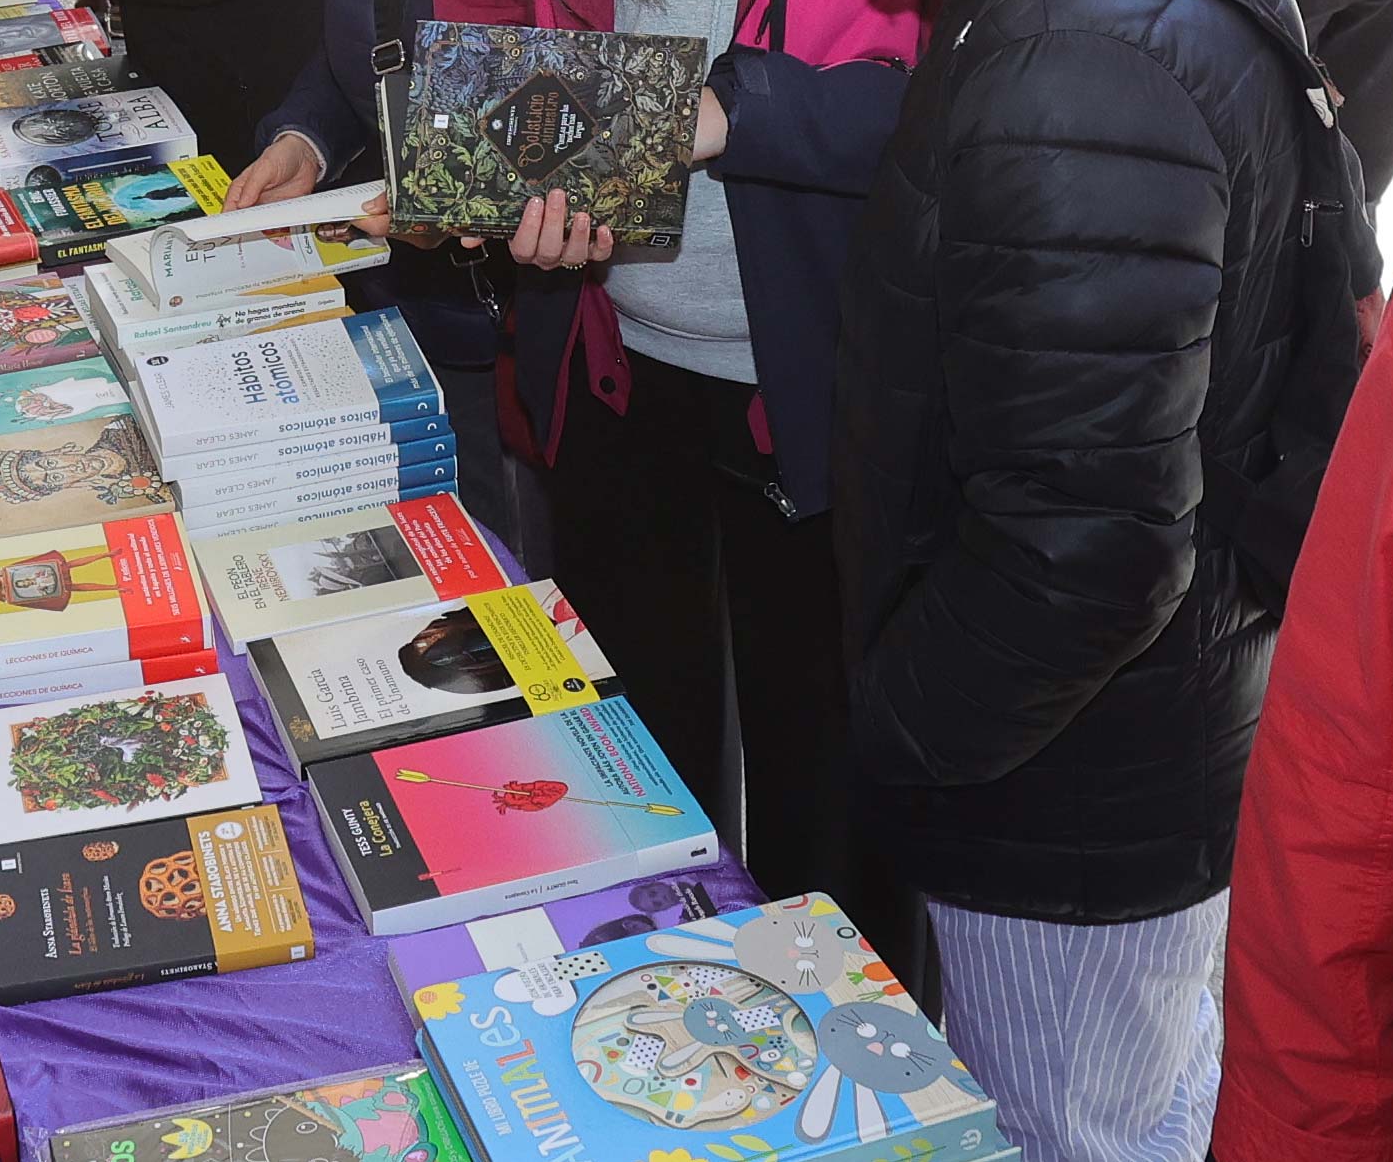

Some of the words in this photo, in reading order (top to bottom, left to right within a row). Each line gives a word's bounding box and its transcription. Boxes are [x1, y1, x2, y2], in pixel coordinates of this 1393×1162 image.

[91, 67, 114, 87] CASA
[27, 81, 44, 100] KATE
[127, 94, 169, 130] ALBA
[543, 92, 559, 144] siniestro
[518, 93, 546, 168] Solsticio
[57, 249, 68, 259] EL
[235, 309, 246, 318] No
[247, 305, 270, 318] hagas
[236, 316, 245, 324] de
[247, 311, 273, 325] granos
[274, 310, 283, 318] de
[284, 307, 305, 317] arena
[134, 327, 161, 339] Rafael
[163, 319, 211, 336] Santandreu
[228, 350, 268, 405] Hábitos
[257, 341, 301, 405] atómicos
[278, 416, 337, 433] atómicos
[196, 433, 228, 446] CLEAR
[229, 430, 260, 443] JAMES
[338, 431, 387, 447] Hábitos
[278, 439, 336, 456] atómicos
[196, 457, 227, 471] CLEAR
[229, 453, 260, 465] JAMES
[350, 452, 400, 469] Hábitos
[295, 462, 349, 480] atómicos
[215, 482, 246, 497] CLEAR
[247, 476, 278, 489] JAMES
[356, 475, 400, 492] Hábitos
[295, 487, 354, 504] atómicos
[215, 505, 247, 519] CLEAR
[248, 500, 278, 512] JAMES
[231, 554, 258, 590] TABLERO
[235, 589, 249, 599] EL
[5, 652, 48, 665] LECCIONES
[49, 651, 59, 660] DE
[60, 645, 94, 659] QUÍMICA
[356, 657, 373, 675] caso
[38, 685, 49, 695] DE
[49, 680, 84, 693] QUÍMICA
[309, 667, 336, 705] García
[364, 673, 392, 705] primer
[375, 658, 409, 702] Unamuno
[336, 674, 375, 731] Jambrina
[377, 704, 394, 720] El
[397, 702, 411, 716] de
[326, 699, 349, 732] Luis
[580, 706, 606, 735] AWARD
[600, 732, 625, 761] BOOK
[611, 759, 647, 797] NATIONAL
[341, 807, 362, 835] GUNTY
[358, 799, 392, 842] Conejera
[354, 832, 373, 857] TESS
[378, 839, 396, 858] La
[199, 831, 226, 900] STAROBINETS
[36, 887, 55, 936] STAROBINETS
[217, 901, 234, 934] ANNA
[43, 937, 58, 958] ANNA
[161, 963, 213, 977] STAROBINETS
[461, 1057, 480, 1073] DE
[467, 1069, 492, 1098] PUZLE
[480, 1095, 505, 1123] LIBRO
[492, 1120, 512, 1137] MI
